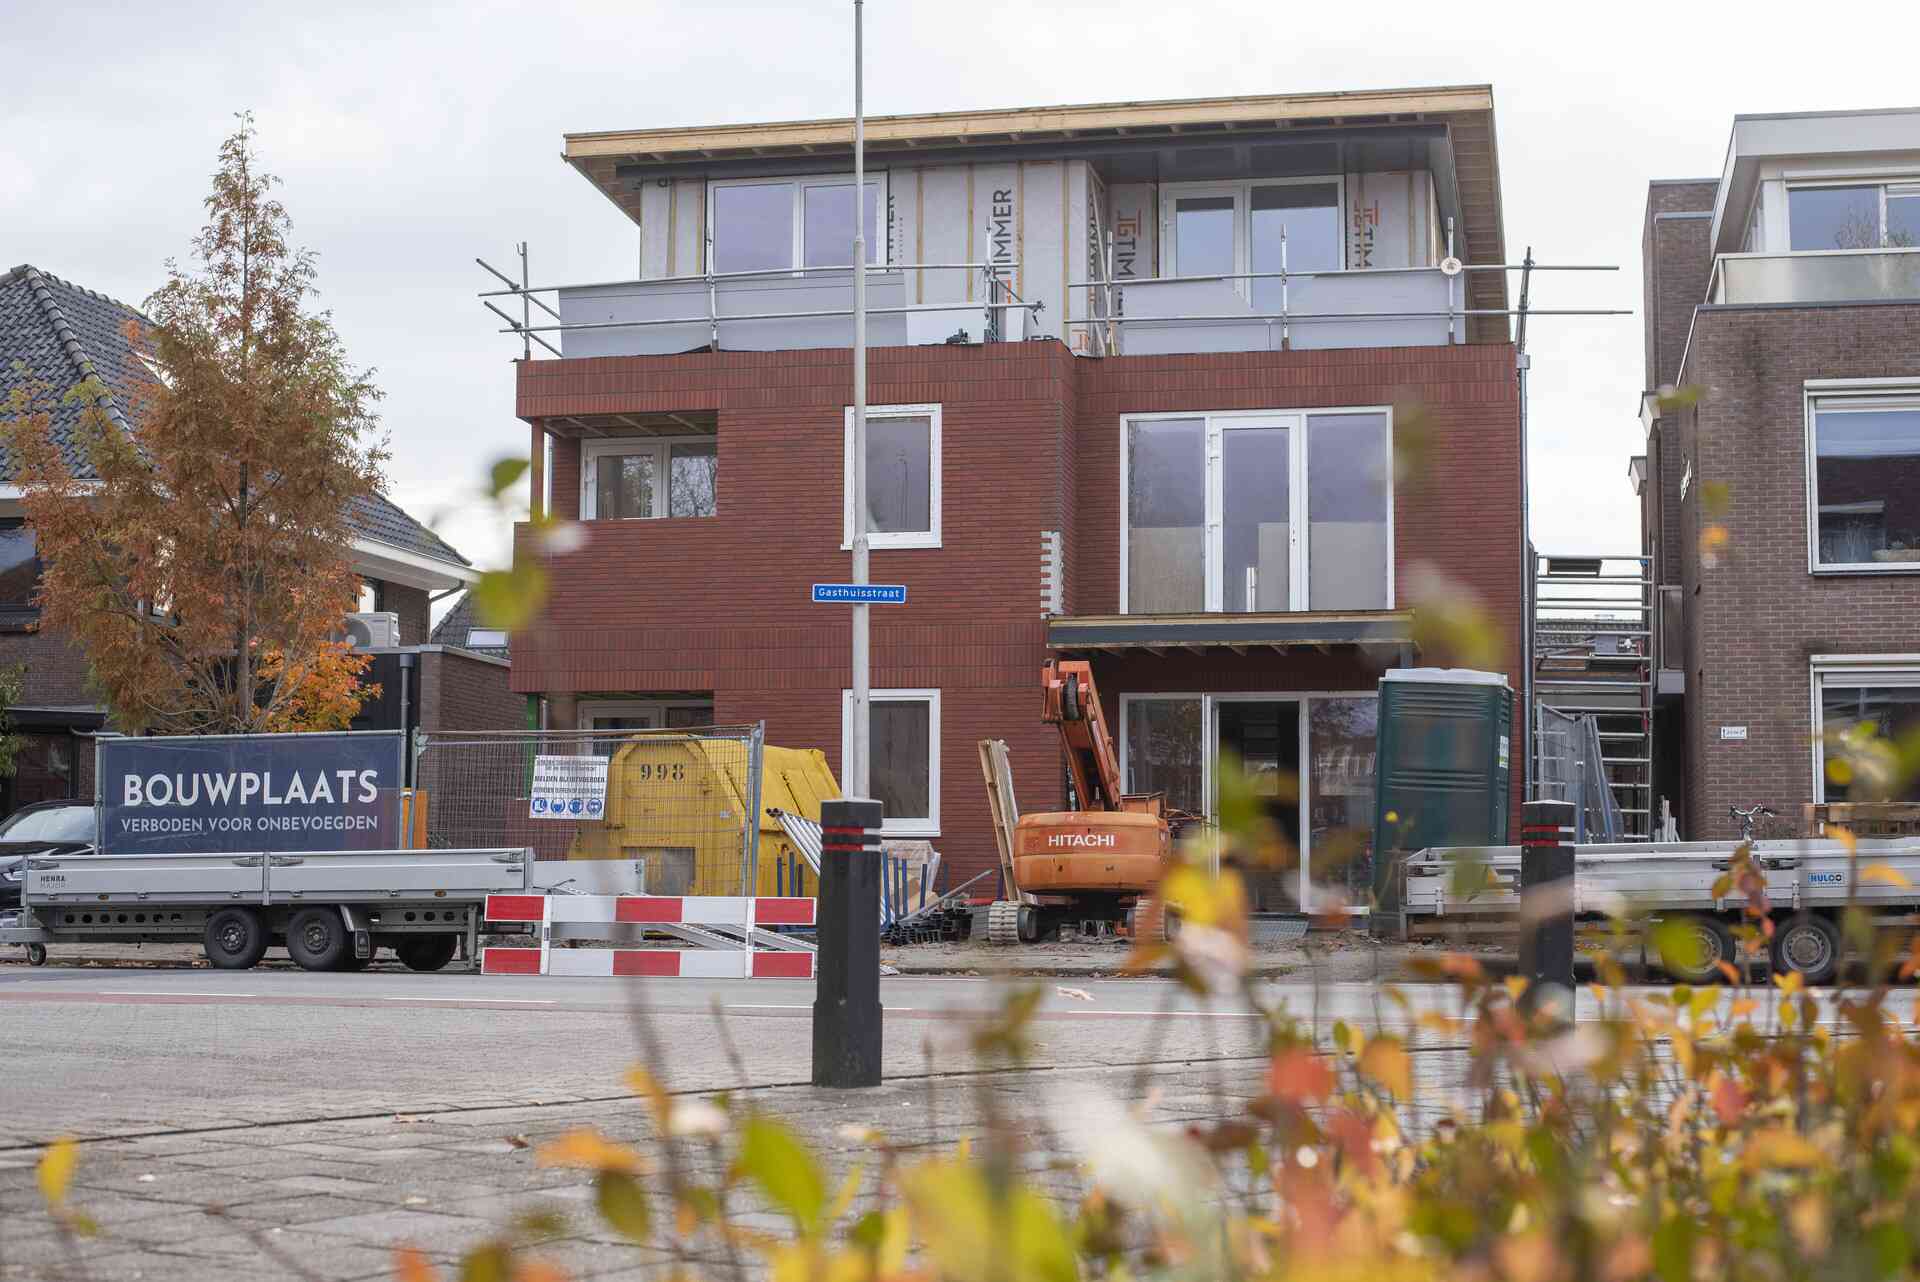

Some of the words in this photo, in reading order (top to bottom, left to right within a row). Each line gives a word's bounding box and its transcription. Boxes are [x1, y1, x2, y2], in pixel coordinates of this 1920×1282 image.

[818, 588, 900, 598] Gasthuisstraat
[640, 763, 685, 781] 998
[124, 769, 378, 807] BOUWPLAATS
[121, 817, 203, 833] VERBODEN
[209, 817, 251, 832] VOOR
[257, 815, 378, 831] ONBEVOEGDEN
[1048, 834, 1115, 847] HITACHI
[1809, 873, 1842, 882] HULCO
